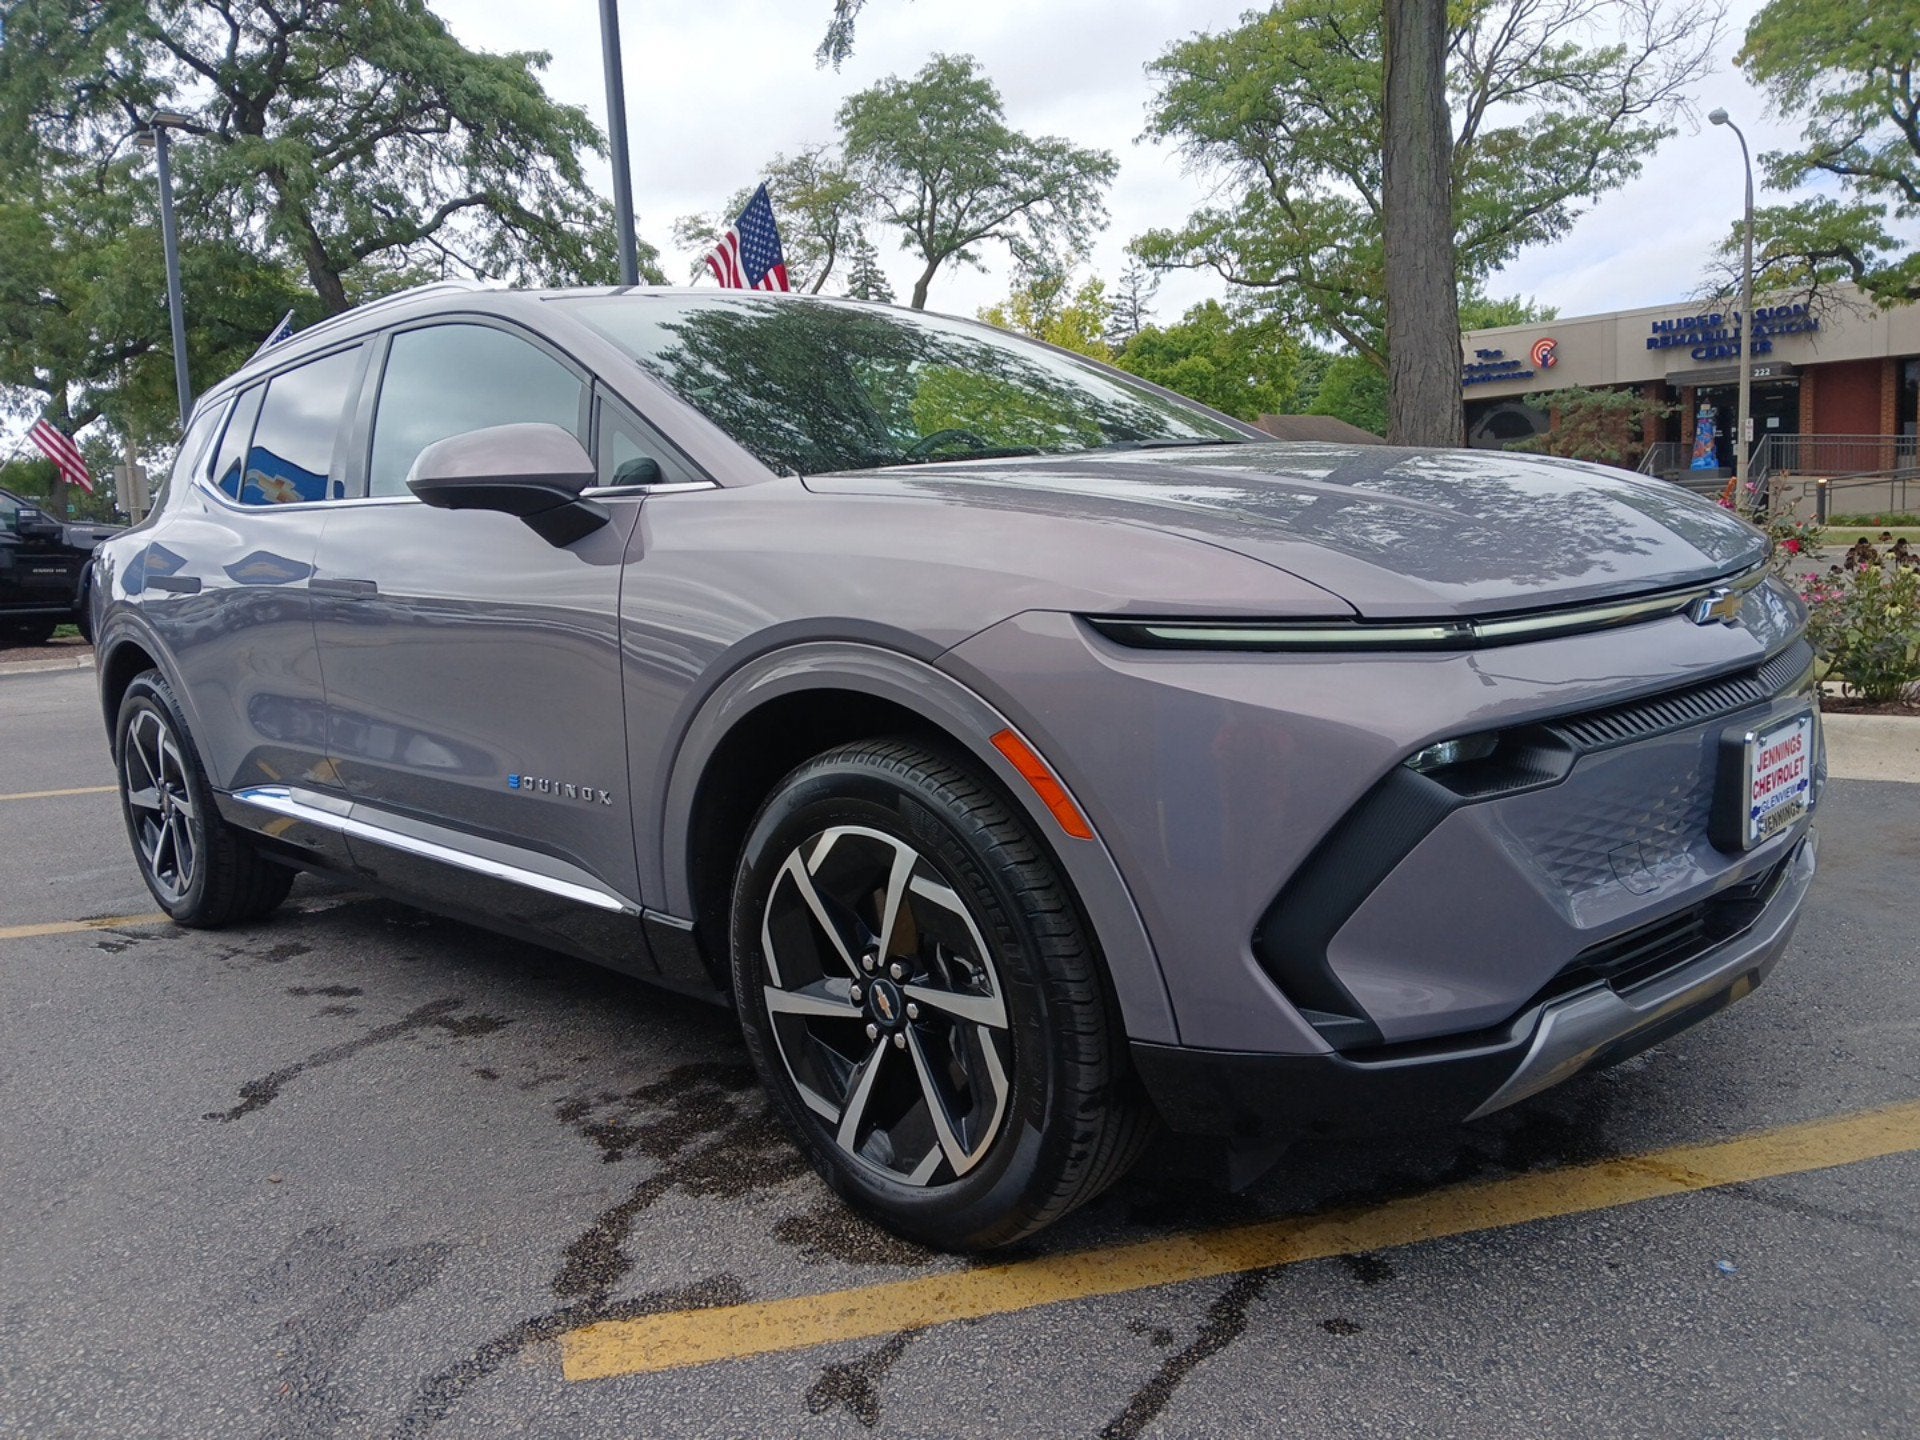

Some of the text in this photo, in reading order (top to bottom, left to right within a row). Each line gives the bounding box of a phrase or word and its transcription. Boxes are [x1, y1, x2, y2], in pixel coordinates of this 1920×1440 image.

[1733, 304, 1809, 324] VSION
[1646, 318, 1819, 350] REHABILIATION
[1691, 340, 1773, 360] CENER
[1754, 367, 1771, 377] 222
[1757, 733, 1802, 773] JENNINGS
[508, 773, 612, 805] EQUINOX
[1752, 755, 1805, 800] CHEVROLET
[1760, 784, 1797, 813] GLENVIEW
